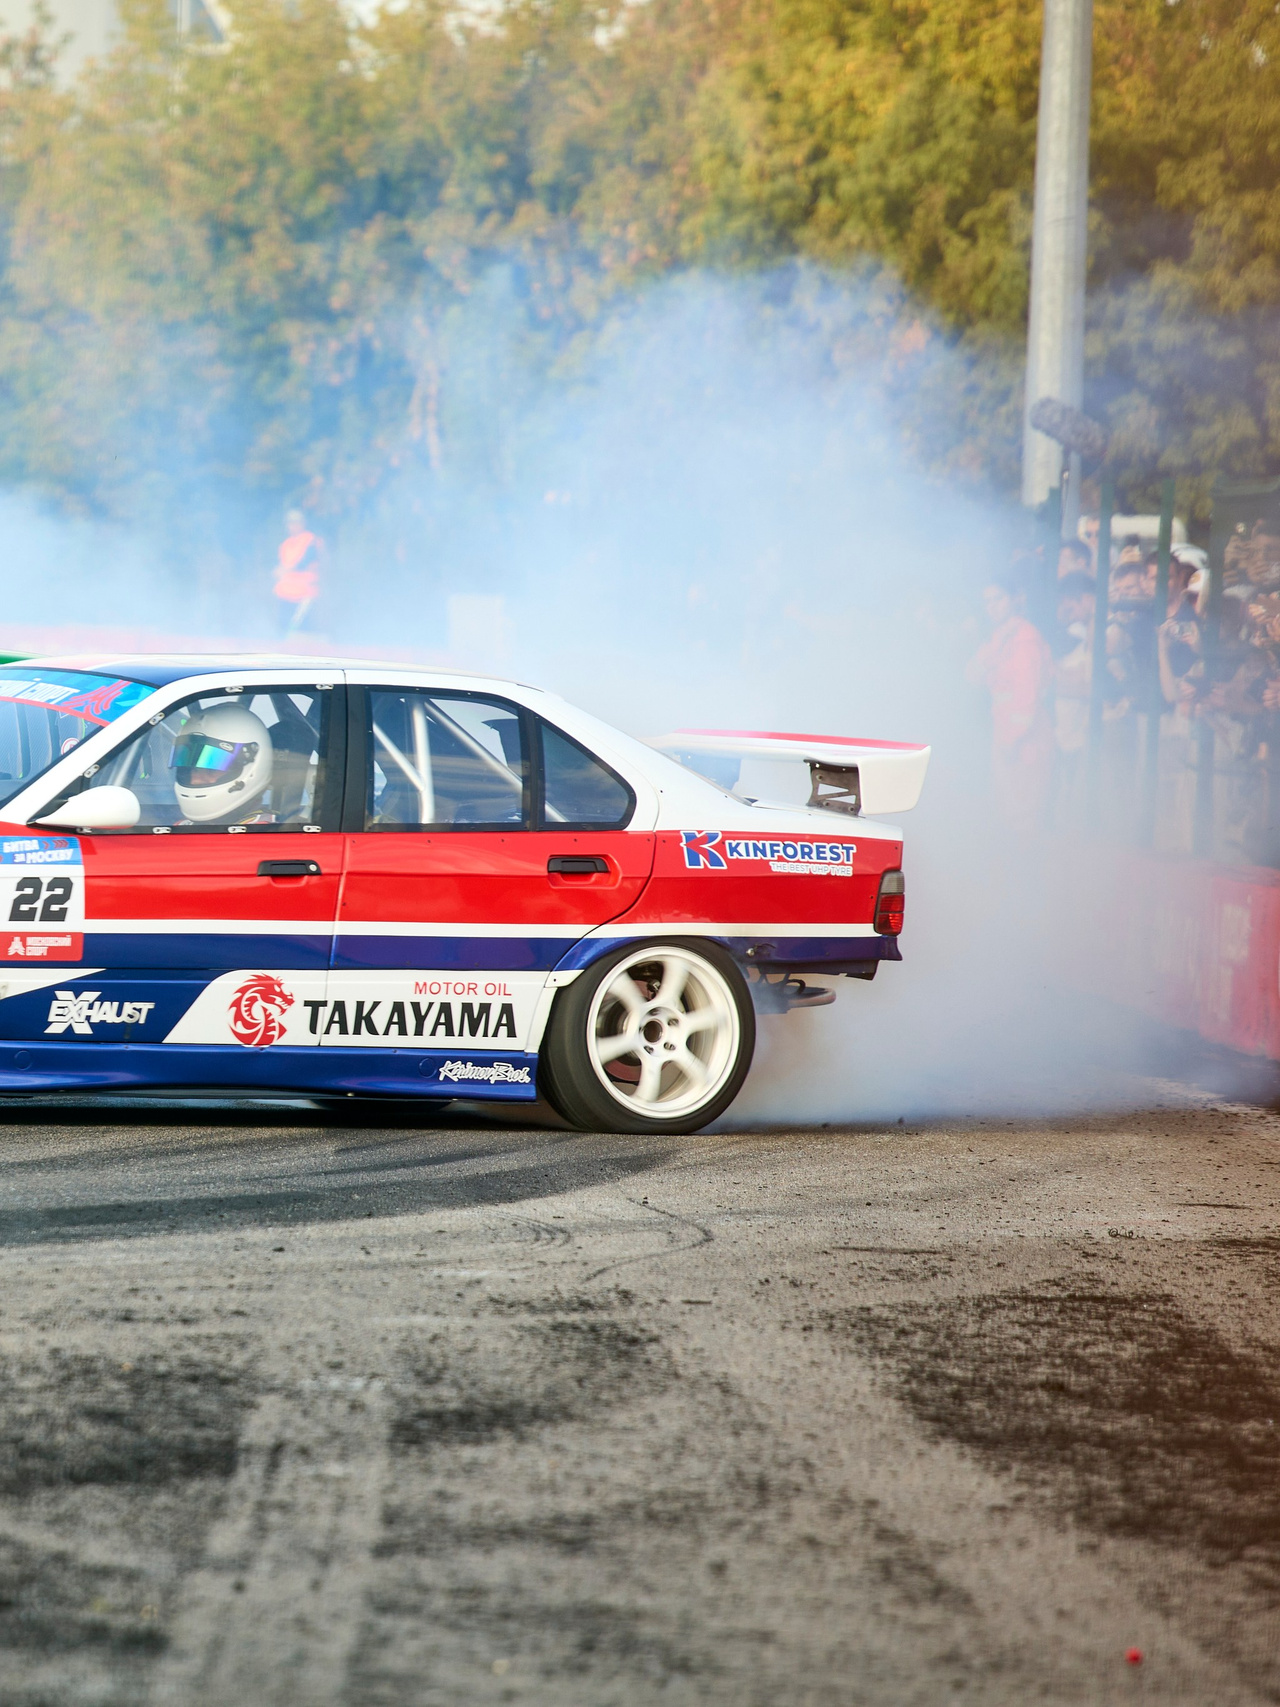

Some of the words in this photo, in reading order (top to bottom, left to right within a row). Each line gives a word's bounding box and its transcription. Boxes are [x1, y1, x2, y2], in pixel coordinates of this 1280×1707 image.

[726, 840, 855, 863] KINFOREST
[771, 862, 788, 871] THE
[789, 863, 810, 872] BEST
[811, 865, 829, 873] UHP
[831, 866, 851, 875] TYRE
[8, 876, 74, 922] 22
[414, 981, 478, 996] MOTOR
[484, 982, 512, 996] OIL
[43, 990, 156, 1034] EXHAUST
[303, 999, 518, 1038] TAKAYAMA
